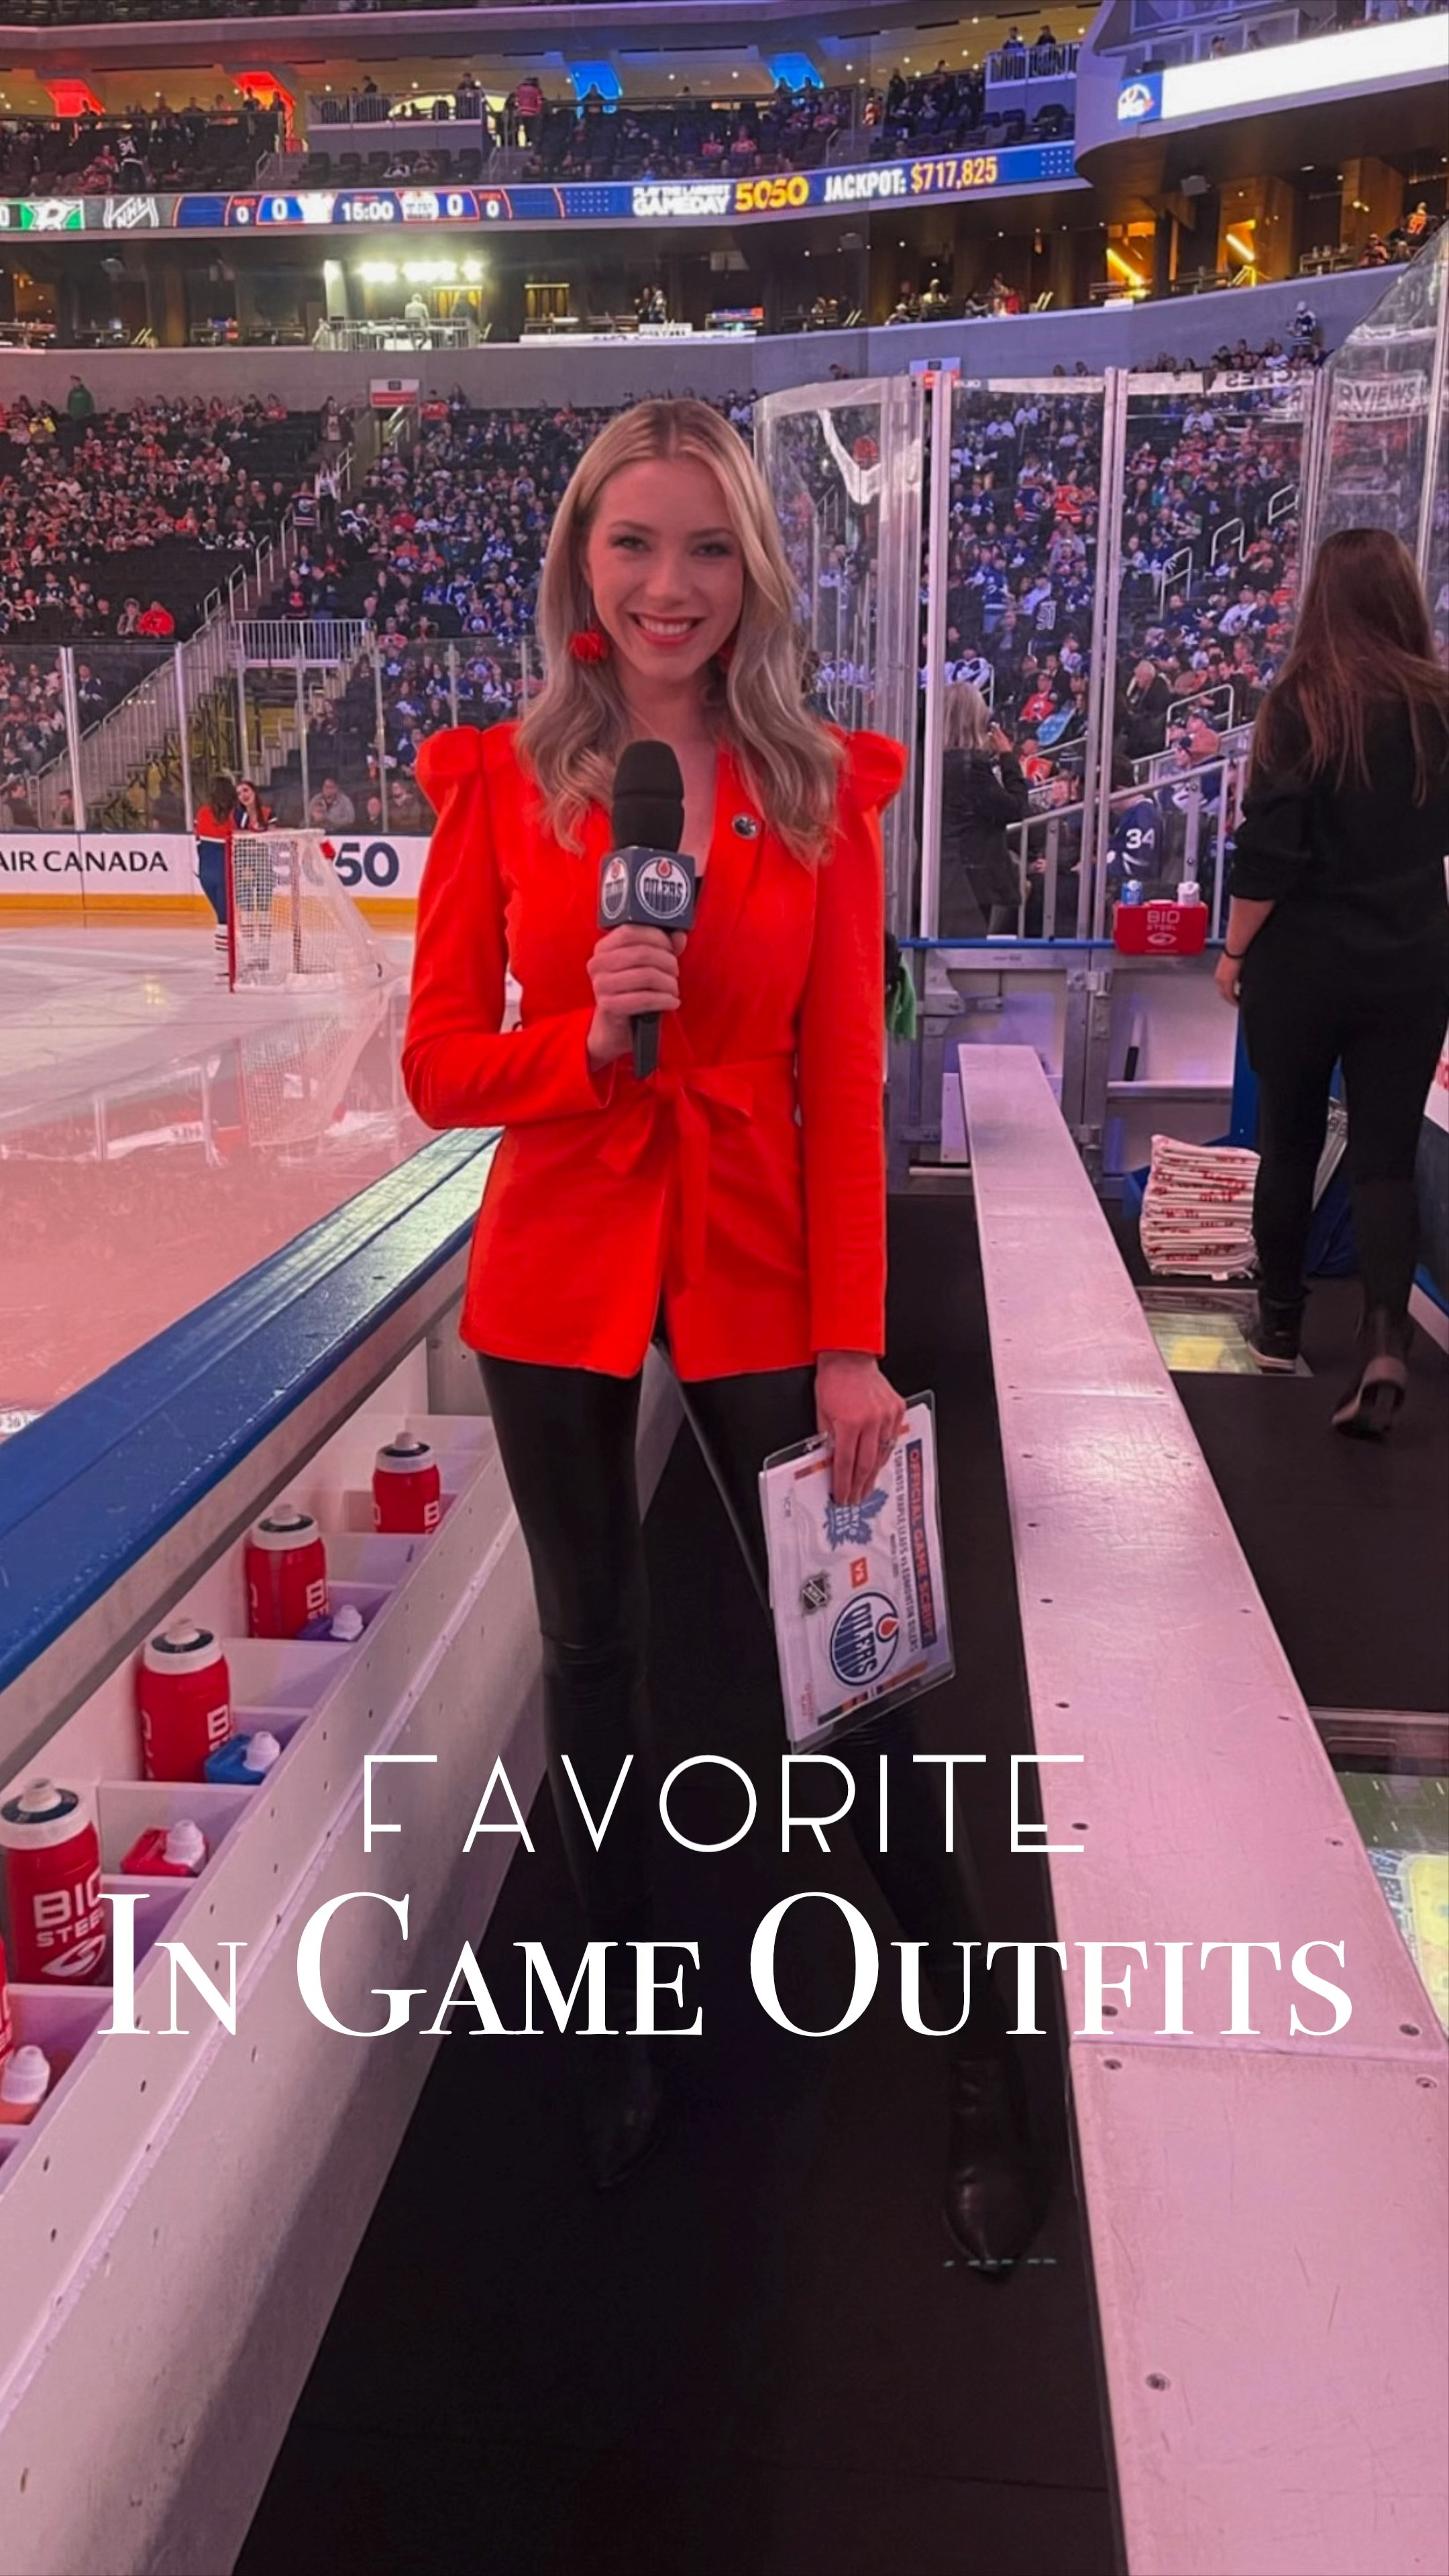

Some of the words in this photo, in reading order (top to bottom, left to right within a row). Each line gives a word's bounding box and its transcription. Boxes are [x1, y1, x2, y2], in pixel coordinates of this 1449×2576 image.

[824, 168, 906, 203] JACKPOT:
[910, 156, 998, 194] $717,825
[735, 175, 809, 211] 5050
[236, 205, 250, 224] 0
[272, 198, 288, 221] 0
[341, 200, 394, 222] 15:00
[447, 193, 464, 217] 0
[486, 200, 499, 218] 0
[633, 195, 729, 216] GAMEDAY
[1126, 827, 1155, 850] 34
[43, 850, 169, 872] CANADA
[1146, 910, 1181, 924] BIO
[909, 1448, 923, 1525] OFFICIAL
[913, 1527, 928, 1572] GAME
[855, 1561, 865, 1582] VS
[918, 1580, 934, 1636] SCRIPT
[835, 1602, 877, 1678] OILERS
